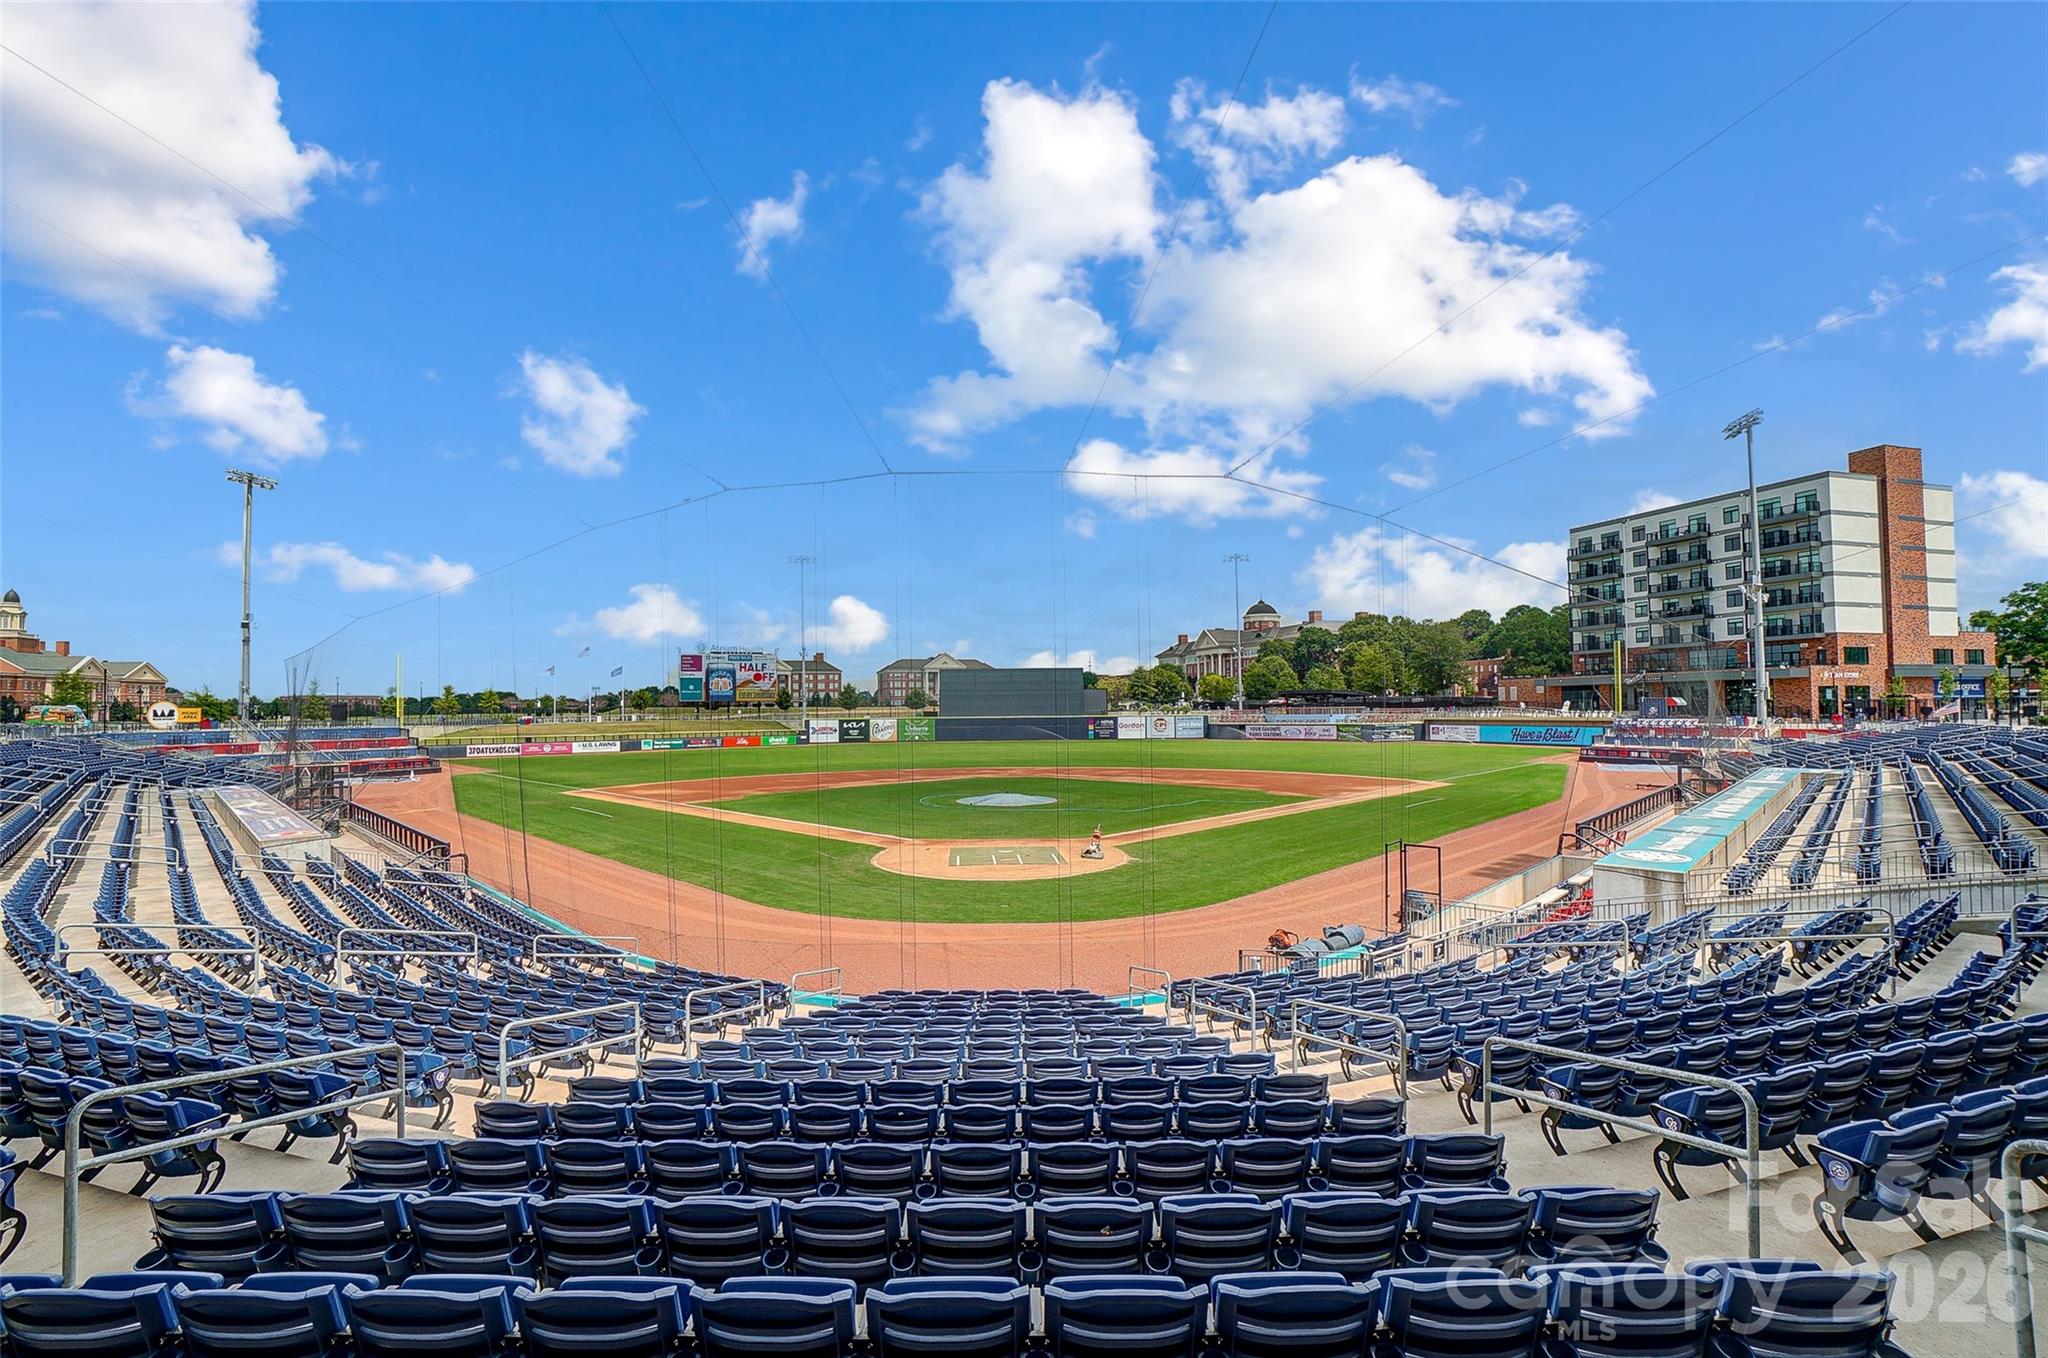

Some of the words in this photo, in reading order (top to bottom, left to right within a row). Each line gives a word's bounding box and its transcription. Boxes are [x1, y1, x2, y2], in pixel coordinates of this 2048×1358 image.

[739, 663, 767, 672] HALF
[753, 673, 775, 682] OFF
[1511, 727, 1535, 742] Have
[1542, 727, 1580, 742] Blast!
